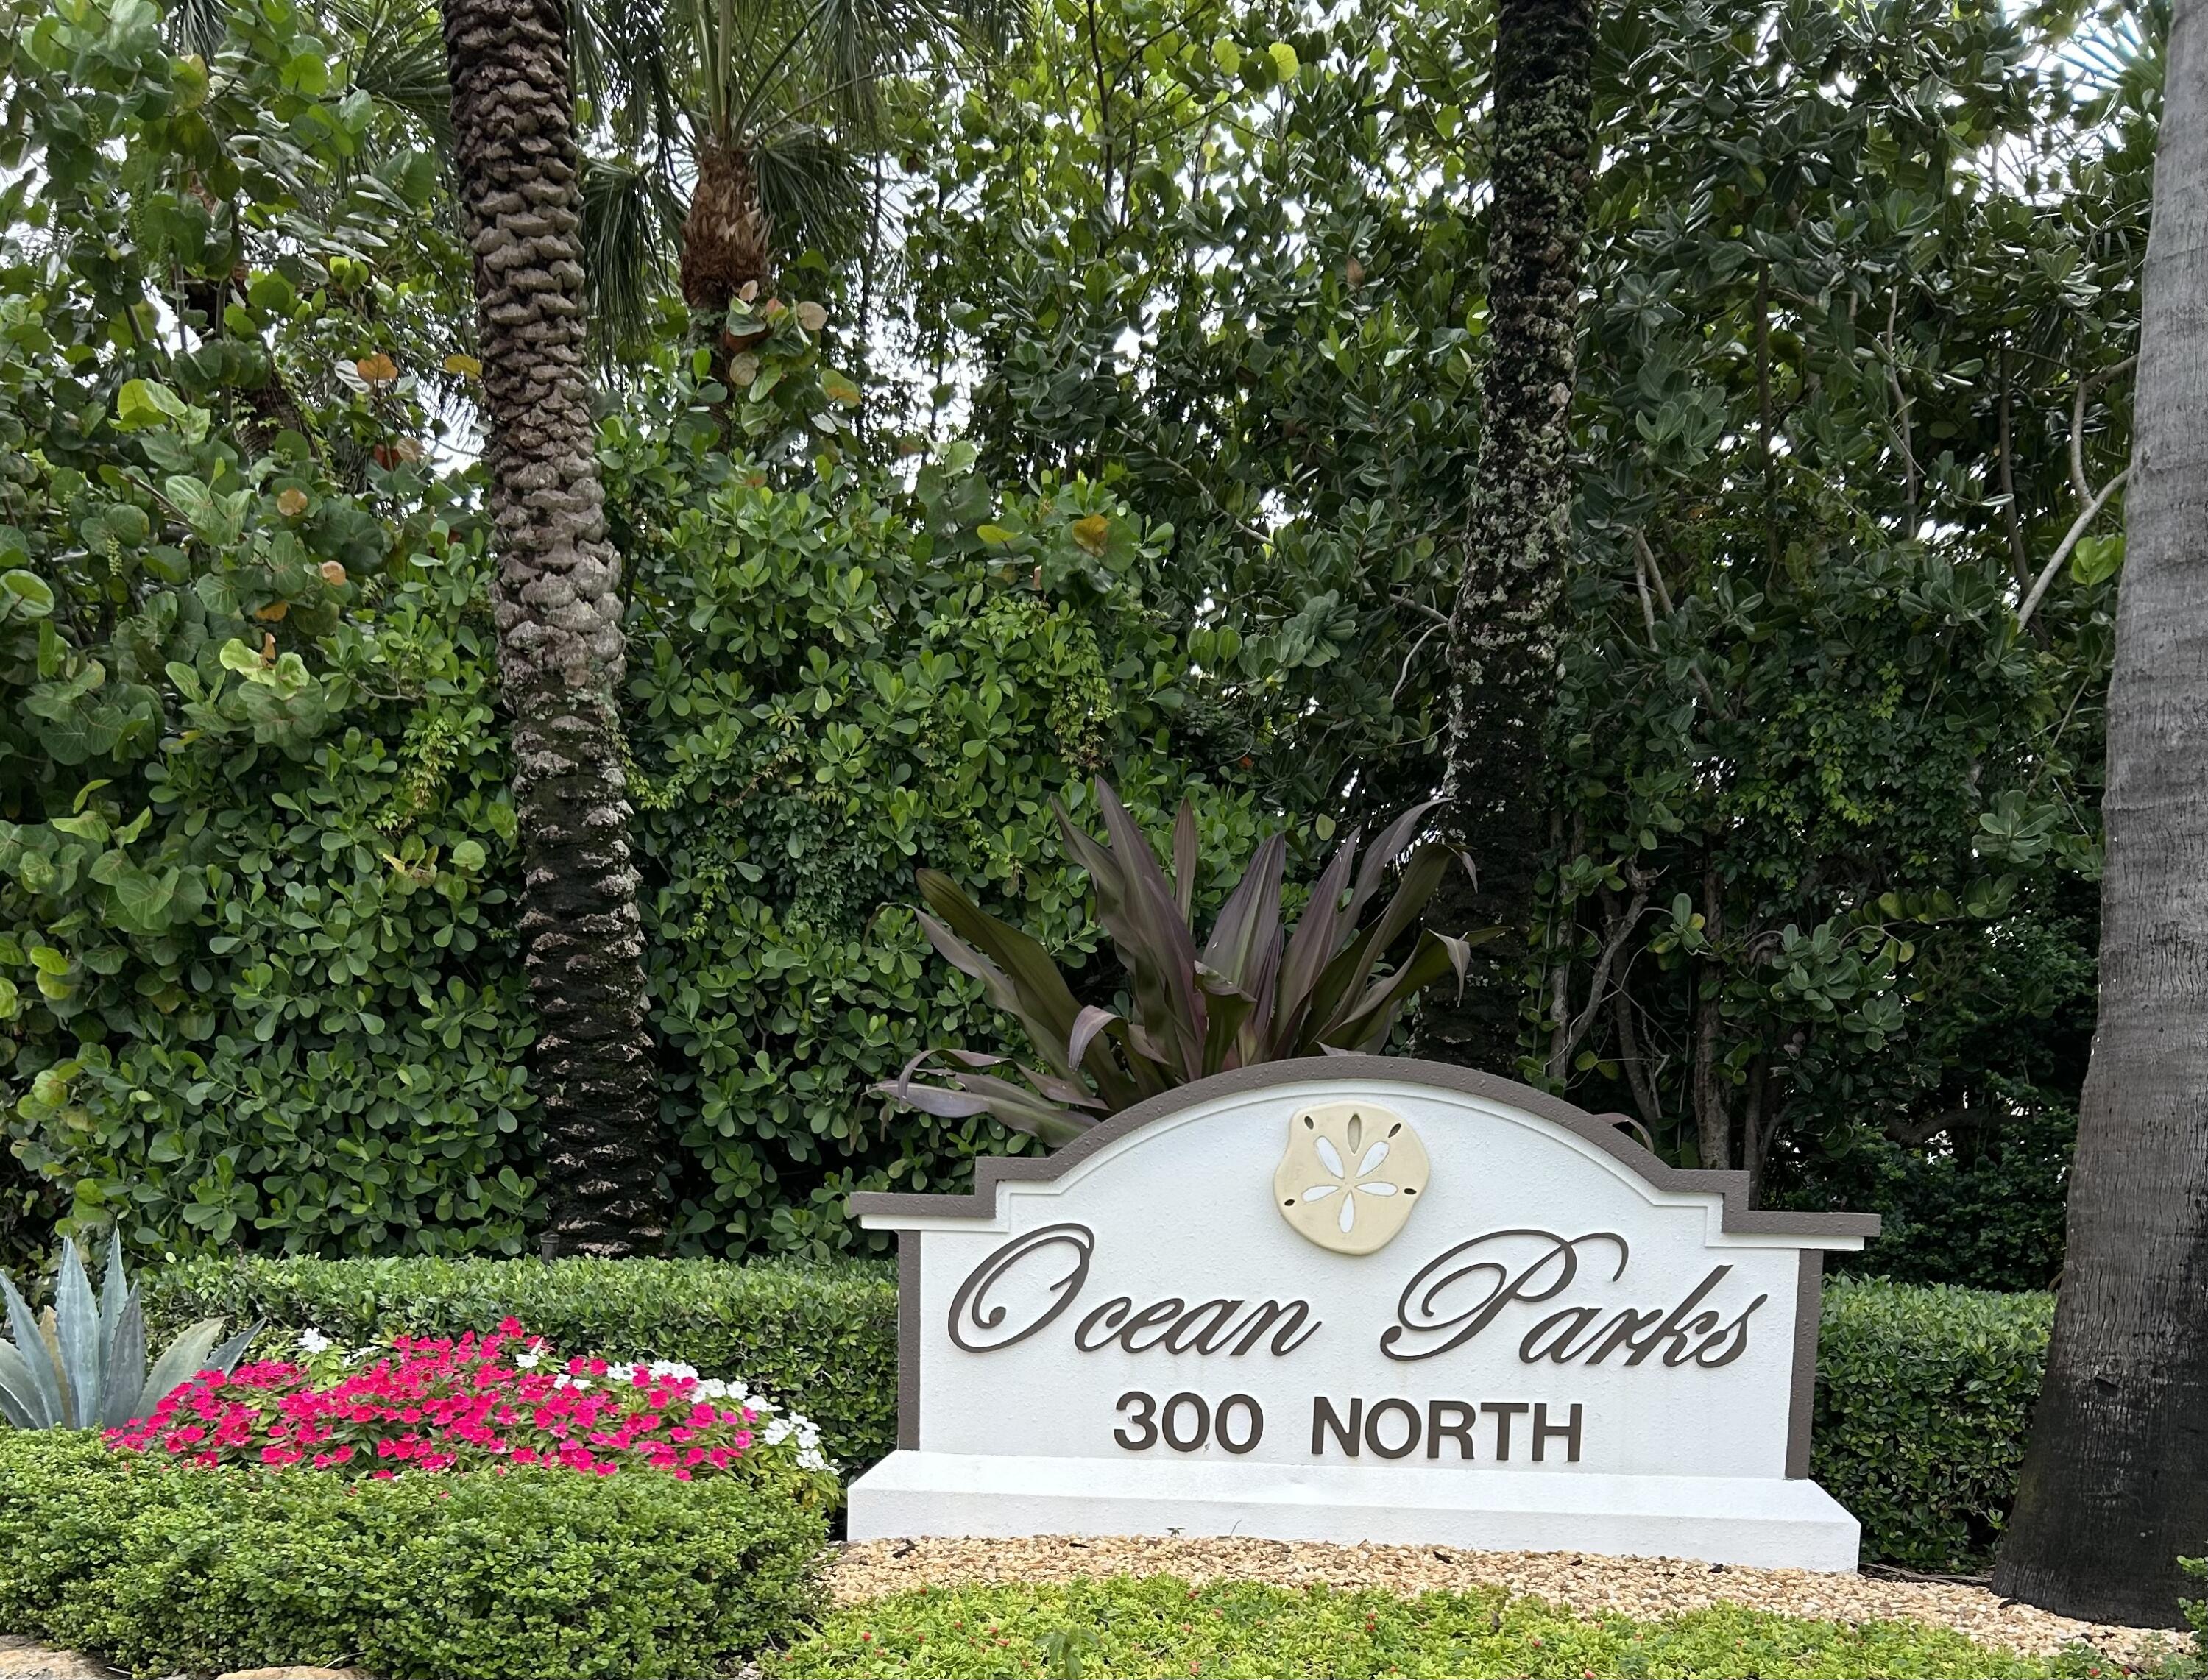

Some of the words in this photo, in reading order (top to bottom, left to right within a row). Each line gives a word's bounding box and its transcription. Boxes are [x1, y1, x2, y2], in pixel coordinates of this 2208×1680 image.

[947, 1222, 1322, 1357] Ocean
[1380, 1227, 1769, 1368] Parks
[1114, 1392, 1263, 1454] 300
[1312, 1397, 1582, 1462] NORTH
